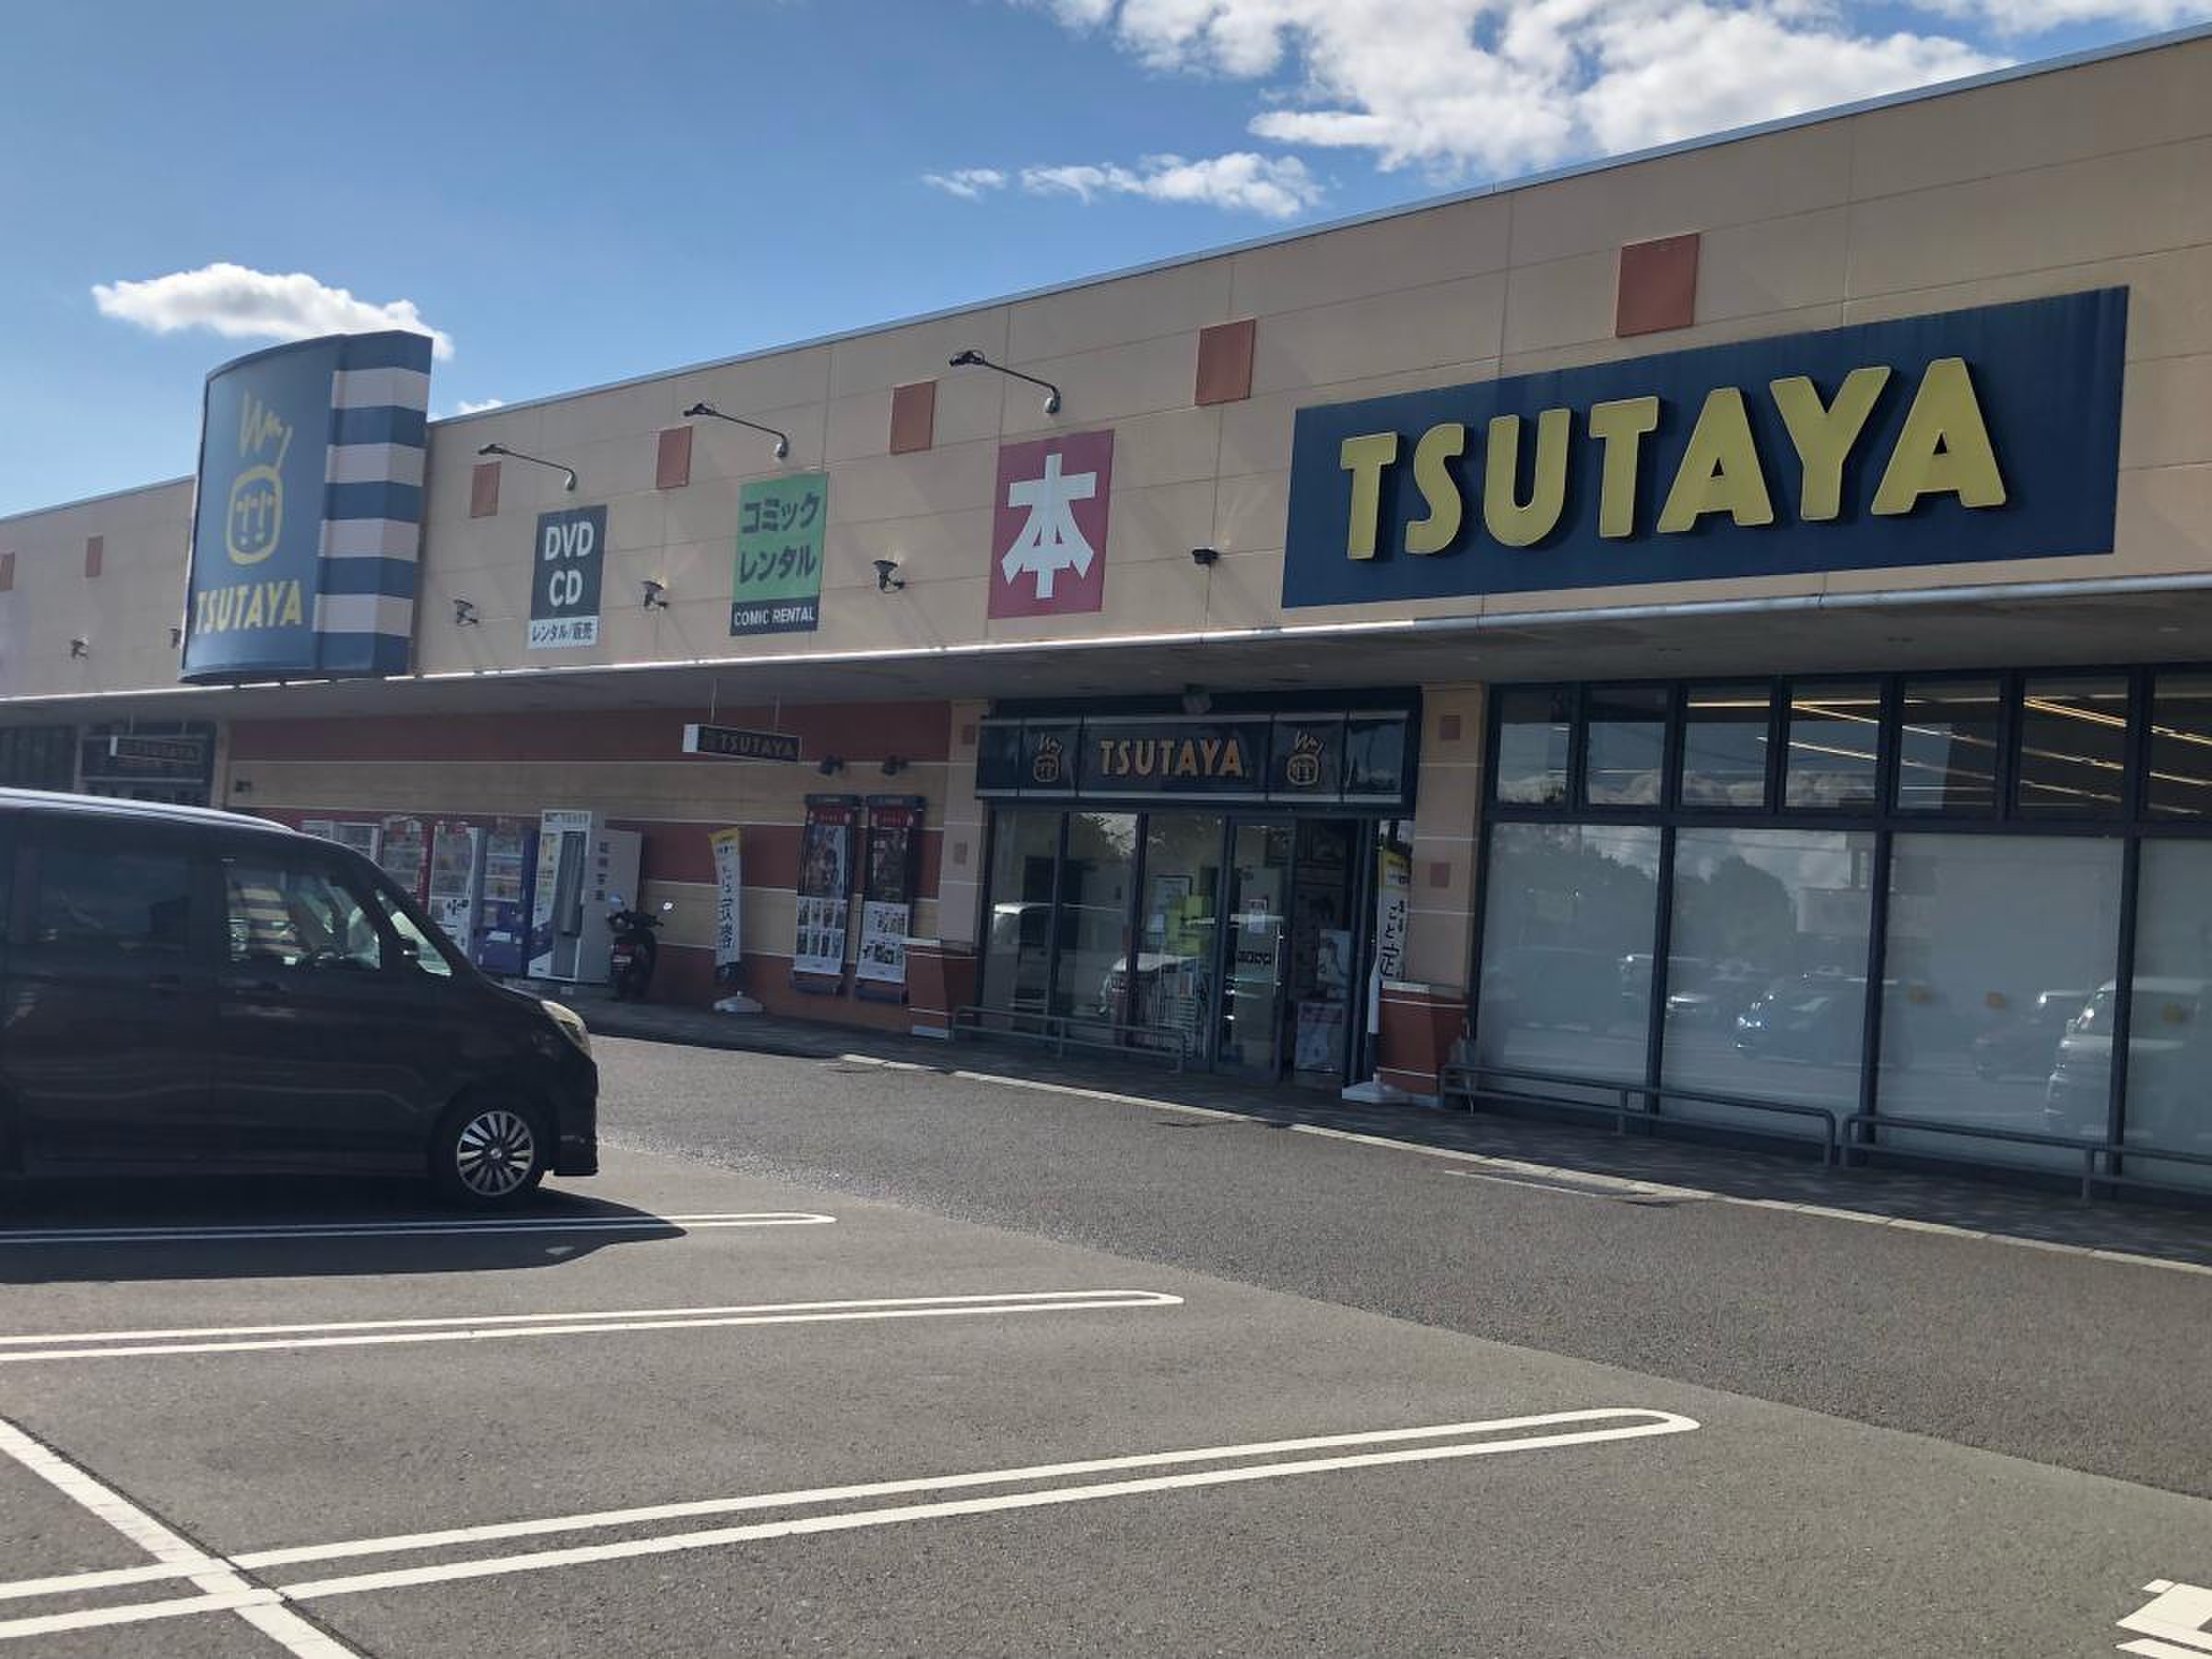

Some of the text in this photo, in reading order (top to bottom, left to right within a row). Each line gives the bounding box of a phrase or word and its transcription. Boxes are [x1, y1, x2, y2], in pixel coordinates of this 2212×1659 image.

[1341, 357, 2006, 560] TSUTAYA
[742, 492, 821, 534] コミック
[1003, 453, 1097, 599] 本
[544, 521, 594, 561] DVD
[739, 545, 817, 583] レンタル
[194, 580, 302, 635] TSUTAYA
[548, 570, 583, 607] CD
[735, 606, 815, 626] COMIC RENTAL
[1100, 738, 1244, 777] TSUTAYA
